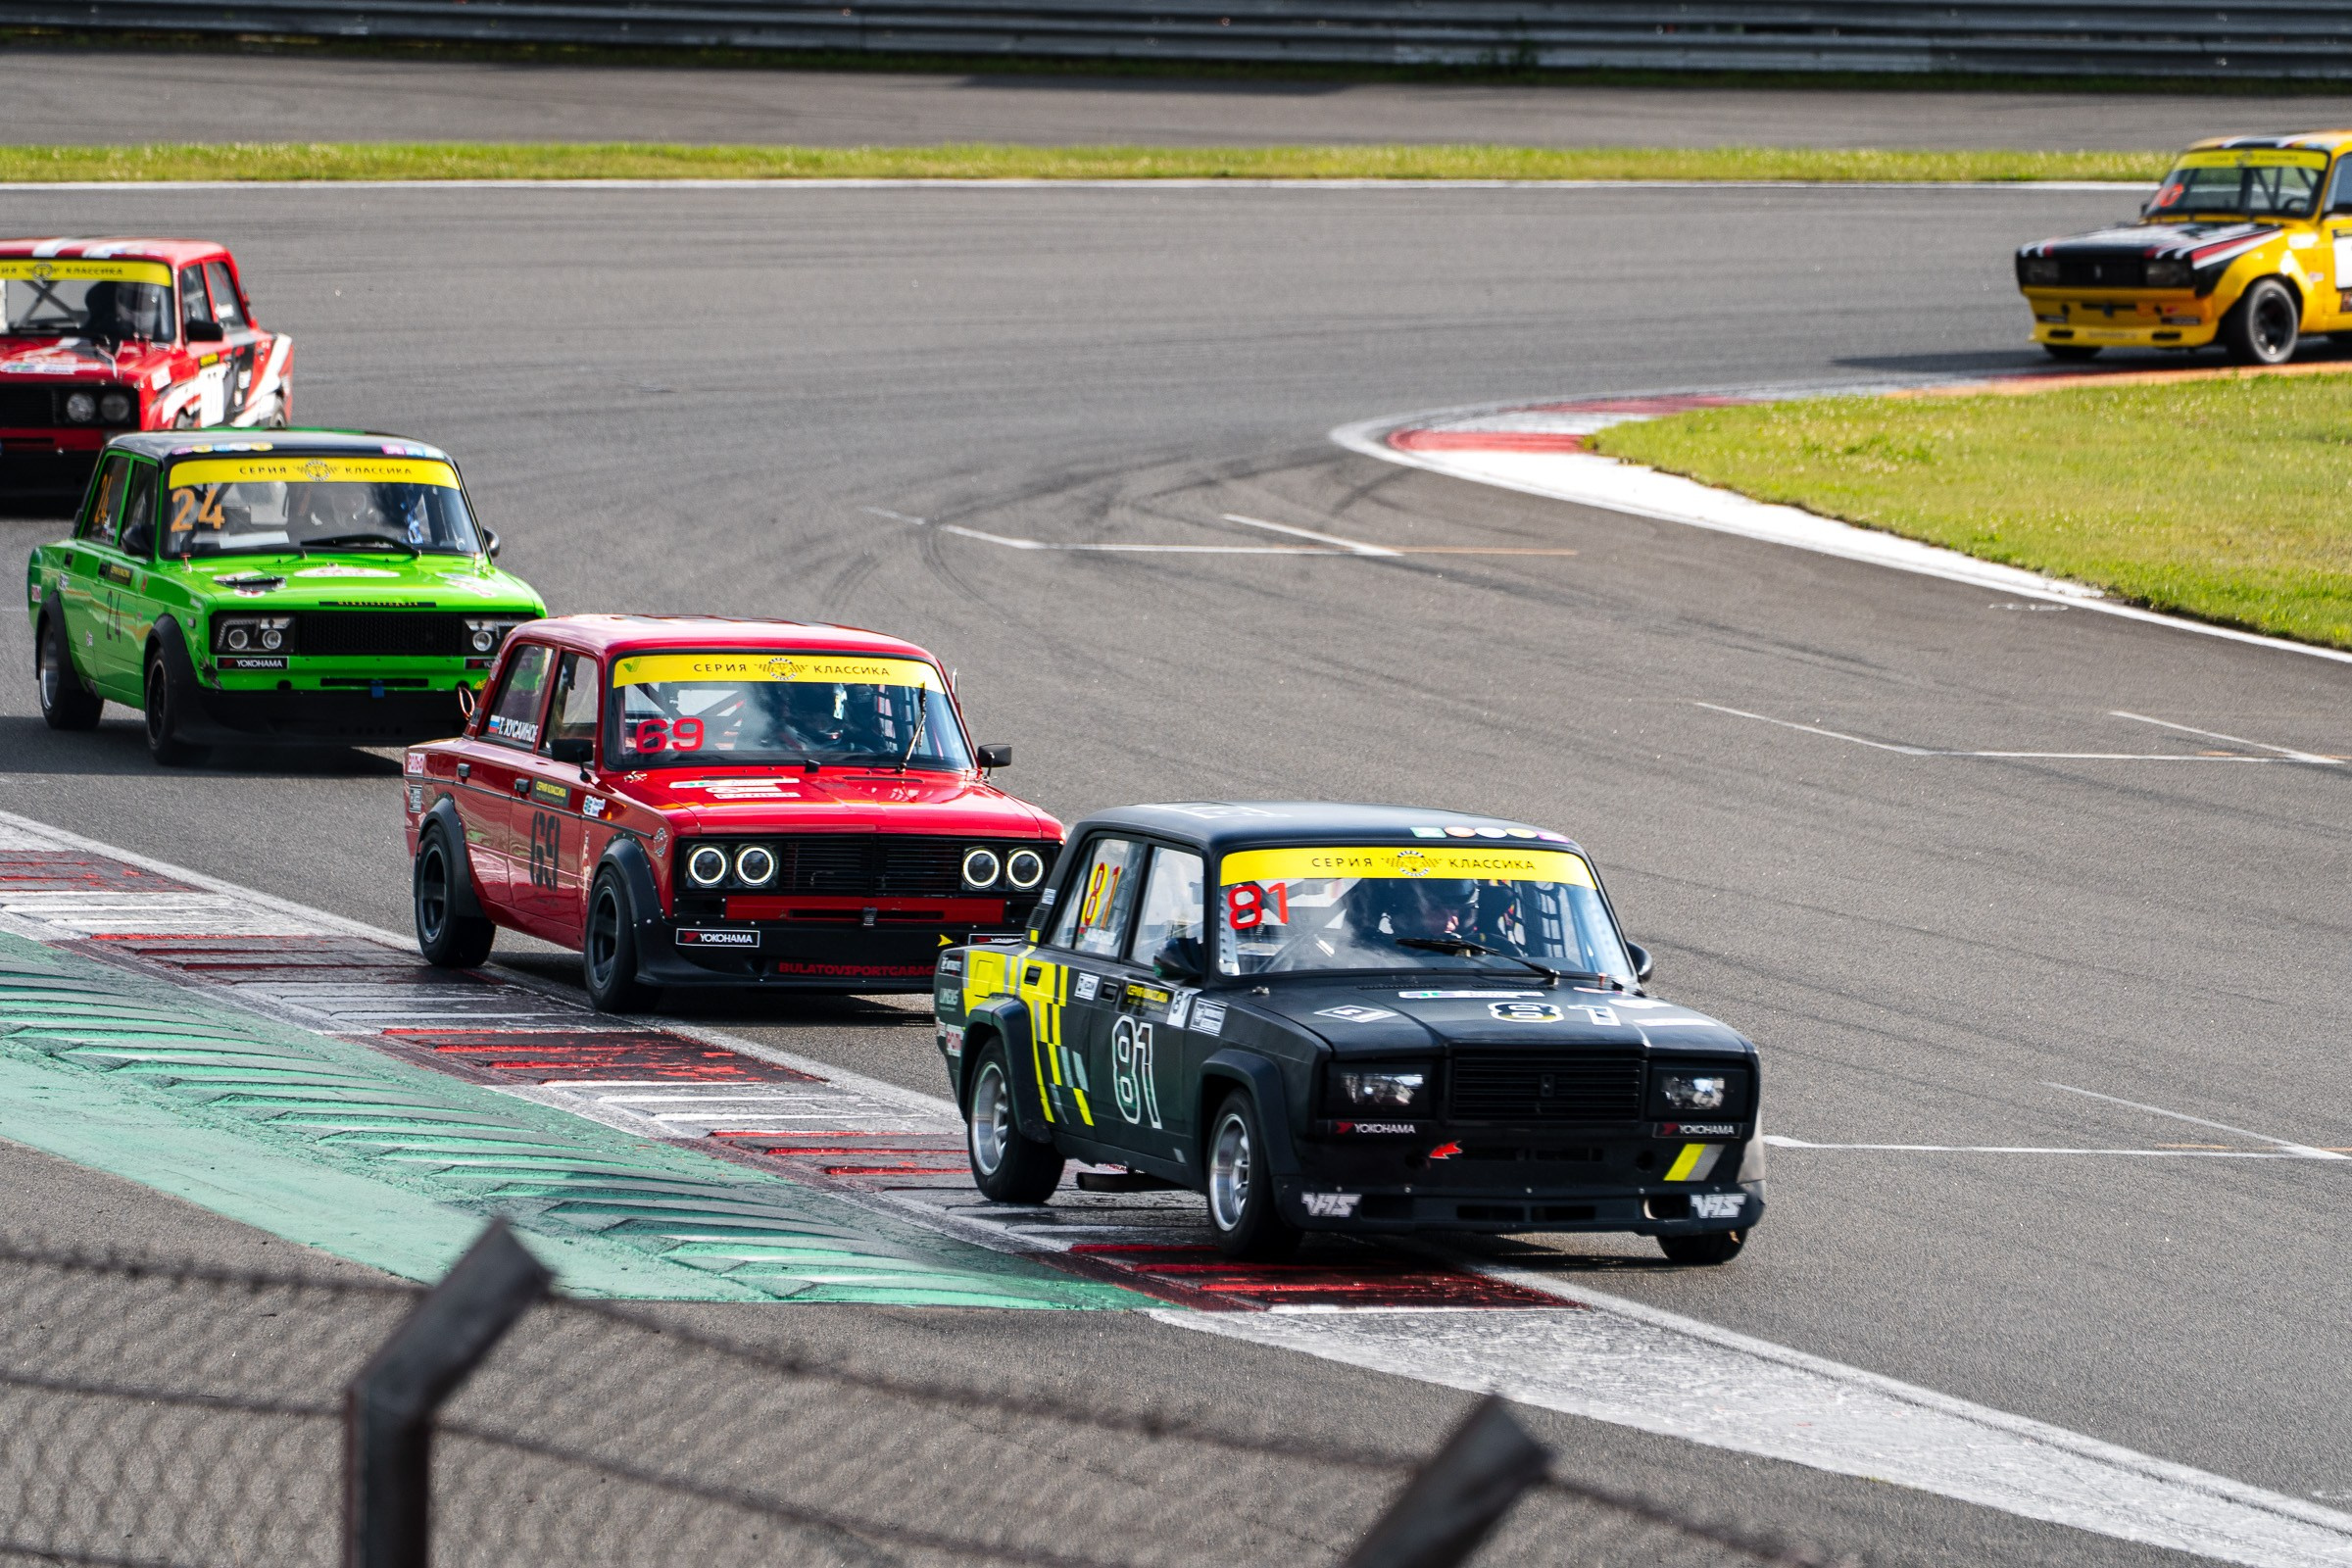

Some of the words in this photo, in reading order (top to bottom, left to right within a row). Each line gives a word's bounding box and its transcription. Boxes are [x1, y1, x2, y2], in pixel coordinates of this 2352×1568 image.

[171, 487, 225, 532] 24
[694, 663, 747, 672] СЕРИЯ
[814, 665, 890, 675] КЛАССИКА
[635, 717, 705, 754] 69
[529, 810, 562, 892] 69
[1311, 858, 1373, 867] СЕРИЯ
[1448, 858, 1537, 870] КЛАССИКА
[1080, 862, 1122, 930] 81
[1228, 882, 1289, 930] 81
[700, 933, 753, 943] YOKOHAMA
[778, 961, 937, 976] BULATOVSPORTGARAG
[1111, 1015, 1163, 1129] 81
[1354, 1123, 1416, 1134] YOKOHAMA
[1678, 1124, 1735, 1135] YOKOHAMA
